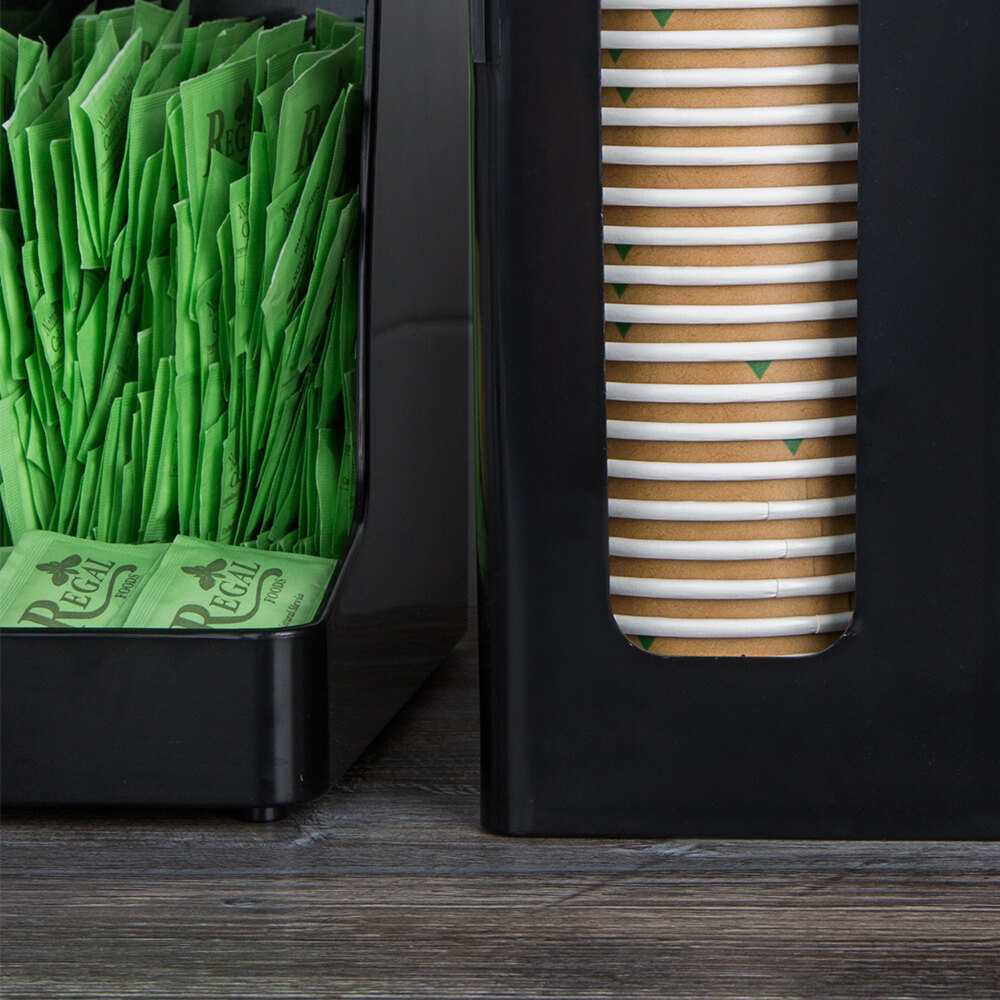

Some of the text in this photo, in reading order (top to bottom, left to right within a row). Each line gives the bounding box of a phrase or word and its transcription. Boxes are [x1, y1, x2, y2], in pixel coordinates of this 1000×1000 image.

[17, 557, 117, 628] REGAL
[114, 573, 141, 599] FOODS
[263, 577, 287, 604] FOODS
